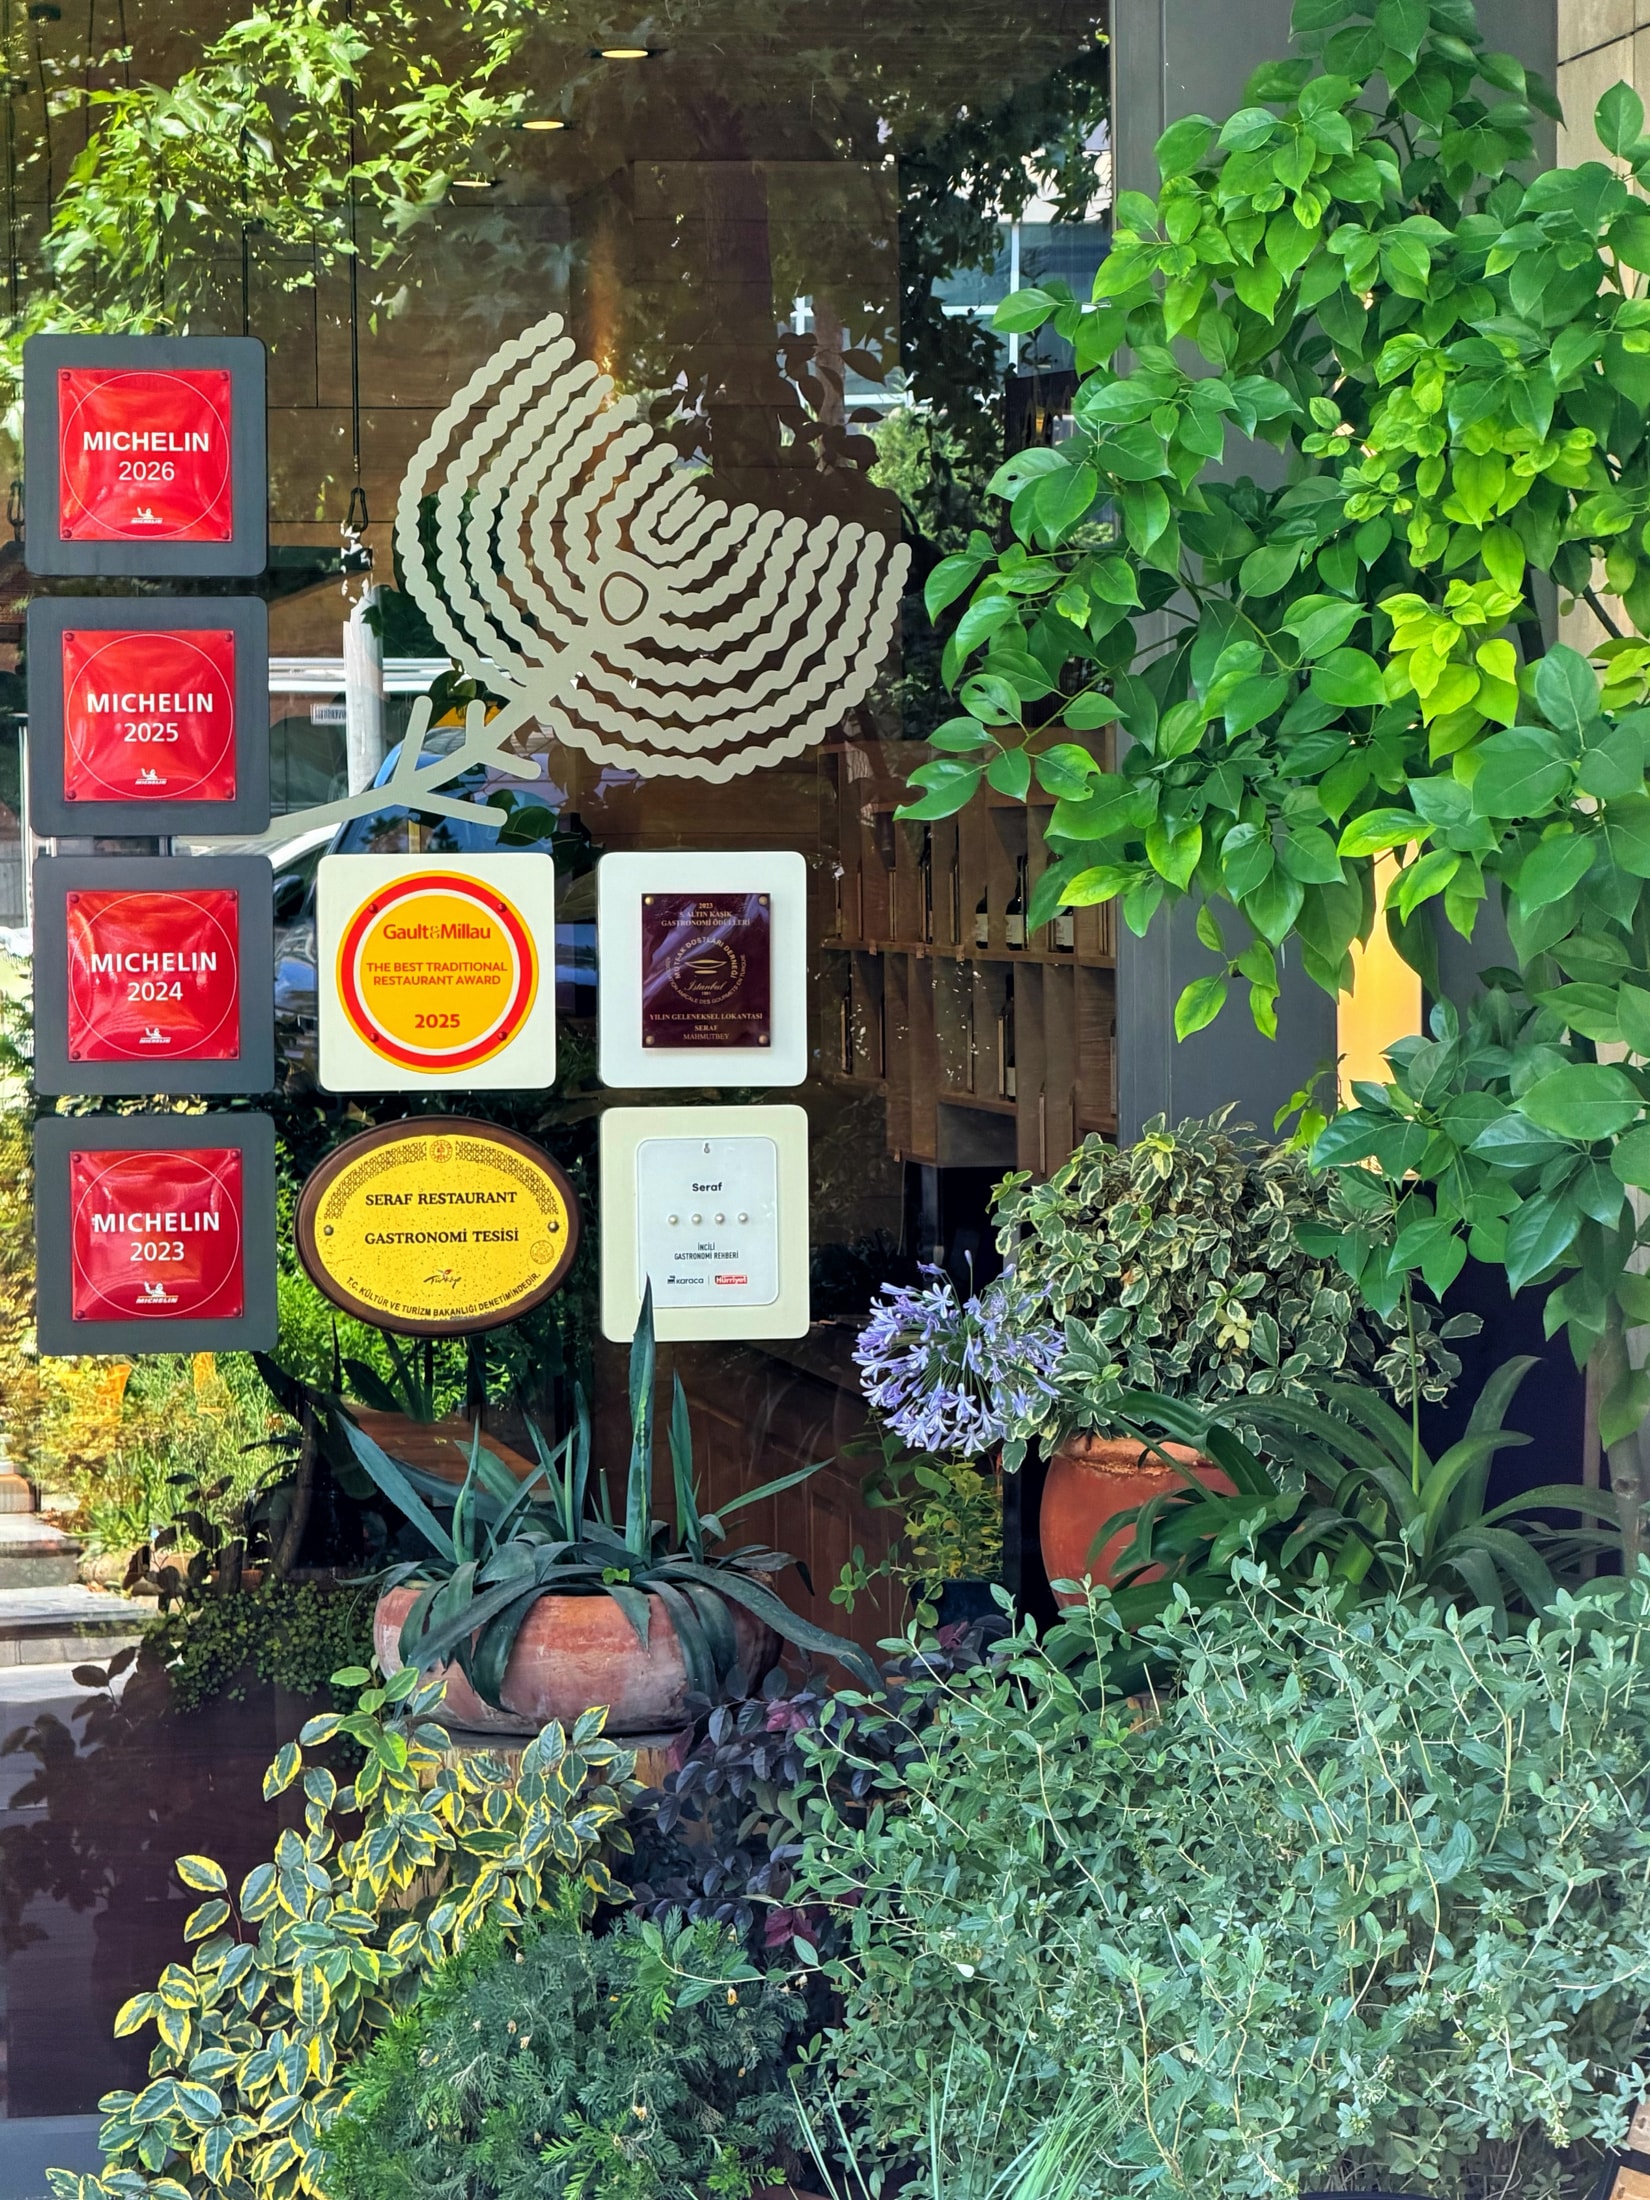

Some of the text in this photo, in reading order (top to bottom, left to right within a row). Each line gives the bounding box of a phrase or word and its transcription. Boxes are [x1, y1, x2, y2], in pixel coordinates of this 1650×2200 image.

[83, 431, 210, 453] MICHELIN
[118, 461, 175, 482] 2026
[86, 692, 214, 714] MICHELIN
[124, 722, 179, 742] 2025
[661, 919, 711, 927] GASTRONOMİ
[90, 952, 217, 973] MICHELIN
[366, 961, 508, 973] THE BEST TRADITIONAL
[373, 975, 501, 986] RESTAURANT AWARD
[128, 982, 183, 1002] 2024
[414, 1014, 460, 1029] 2025
[721, 1012, 763, 1020] LOKANTASI
[692, 1182, 722, 1192] Seraf
[365, 1191, 518, 1206] SERAF RESTAURANT
[94, 1211, 220, 1233] MICHELIN
[364, 1226, 519, 1244] GASTRONOMİ TESİSİ
[130, 1241, 185, 1262] 2023
[674, 1250, 738, 1260] GASTRONOMİ REHBERİ
[698, 1242, 715, 1251] İNCİLİ
[346, 1276, 358, 1291] T.C.
[358, 1286, 389, 1307] KÜLTÜR
[390, 1301, 400, 1311] VE
[402, 1304, 431, 1316] TURİZM
[434, 1304, 478, 1317] BAKANLIĞI
